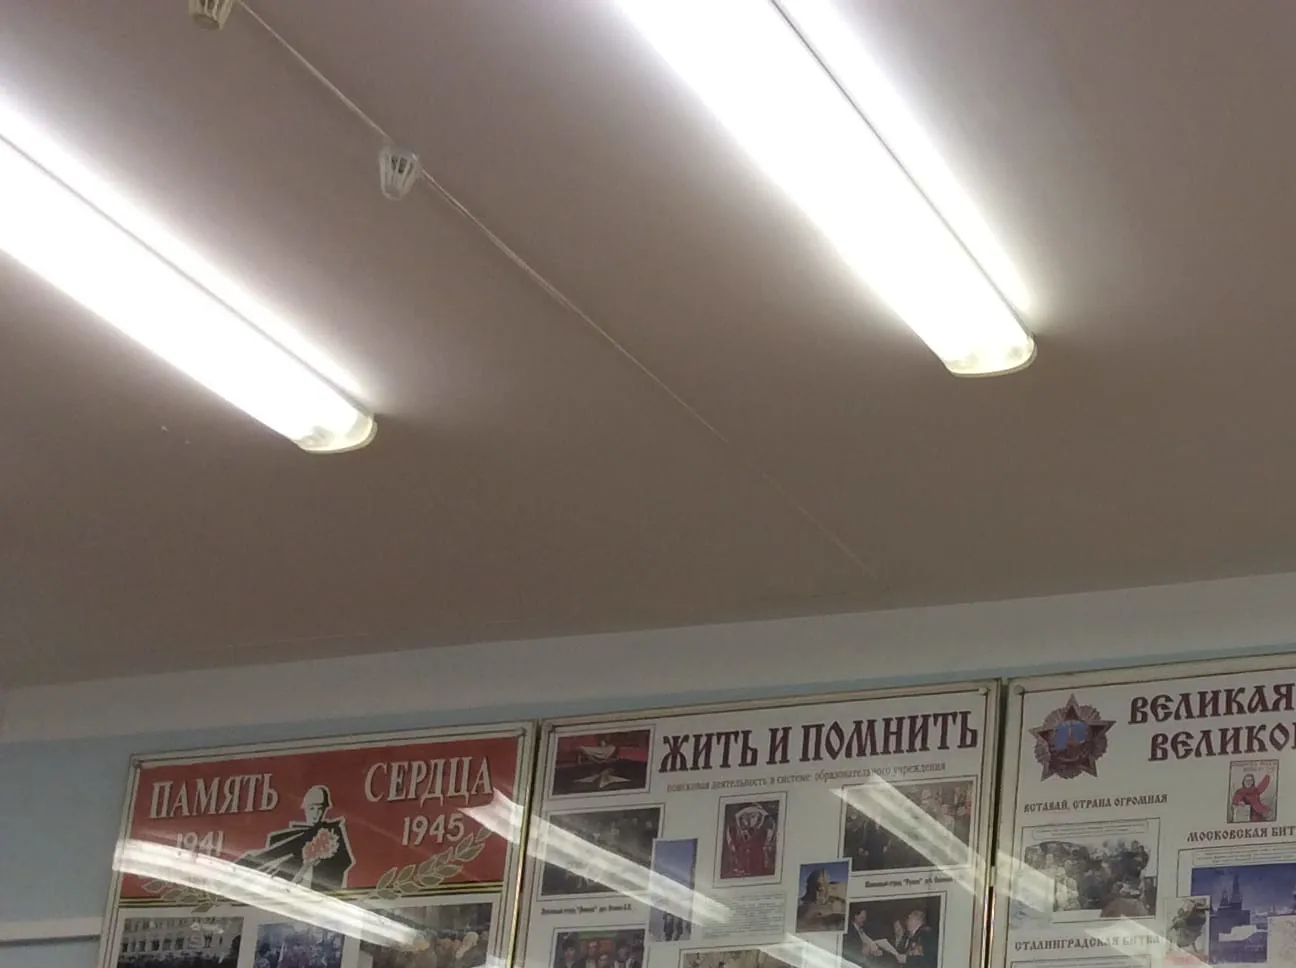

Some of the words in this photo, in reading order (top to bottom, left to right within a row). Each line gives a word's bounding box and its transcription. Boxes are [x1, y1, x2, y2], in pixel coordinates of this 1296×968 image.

[1128, 683, 1295, 725] ВЕЛИКАЯ
[658, 729, 758, 773] ЖИТЬ
[766, 726, 792, 765] И
[799, 710, 978, 762] ПОМНИТЬ
[149, 773, 279, 819] ПАМЯТЬ
[364, 755, 493, 808] СЕРДЦА
[1072, 797, 1112, 810] СТРАНА
[1114, 794, 1168, 807] ОГРОМНАЯ
[402, 813, 465, 846] 1945
[1187, 828, 1268, 842] МОСКОВСКАЯ
[1015, 936, 1119, 951] СТАЛИНГРАДСКАЯ
